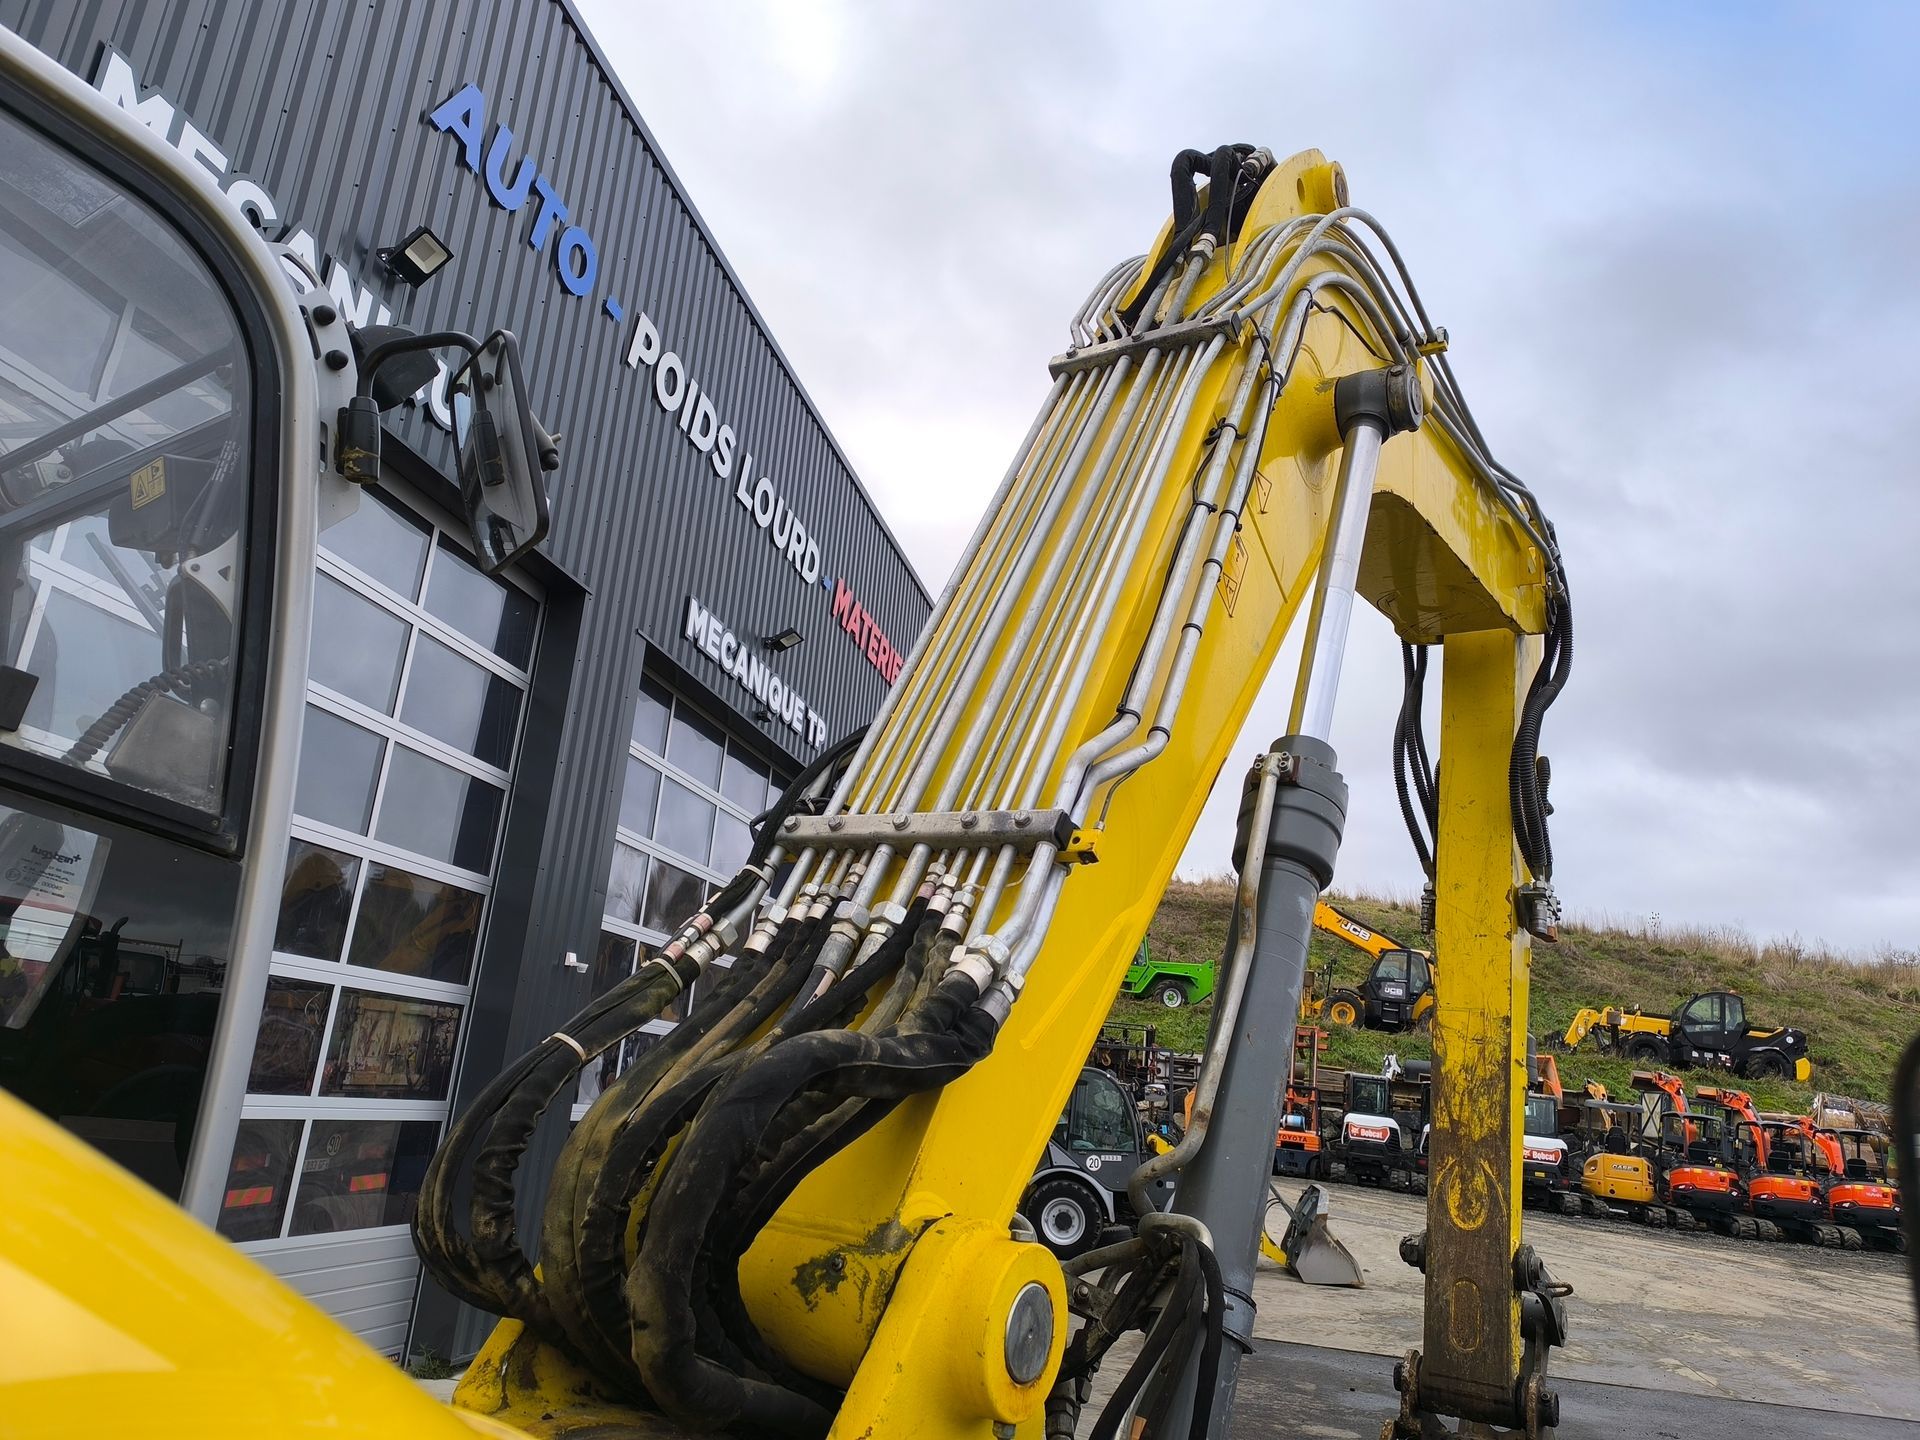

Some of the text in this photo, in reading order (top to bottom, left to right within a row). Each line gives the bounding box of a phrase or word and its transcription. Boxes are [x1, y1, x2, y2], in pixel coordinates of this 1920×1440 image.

[430, 83, 597, 297] AUTO
[627, 312, 738, 479] POIDS
[736, 452, 820, 585] LOURD
[685, 597, 827, 749] MECANIQUE TP
[1341, 921, 1370, 940] JCB
[1384, 986, 1403, 996] JCB
[1278, 1134, 1307, 1142] TOYOTA
[1360, 1128, 1383, 1139] Bobcat
[1532, 1150, 1556, 1161] Bobcat
[1088, 1157, 1100, 1169] 20
[1612, 1164, 1633, 1172] CASE
